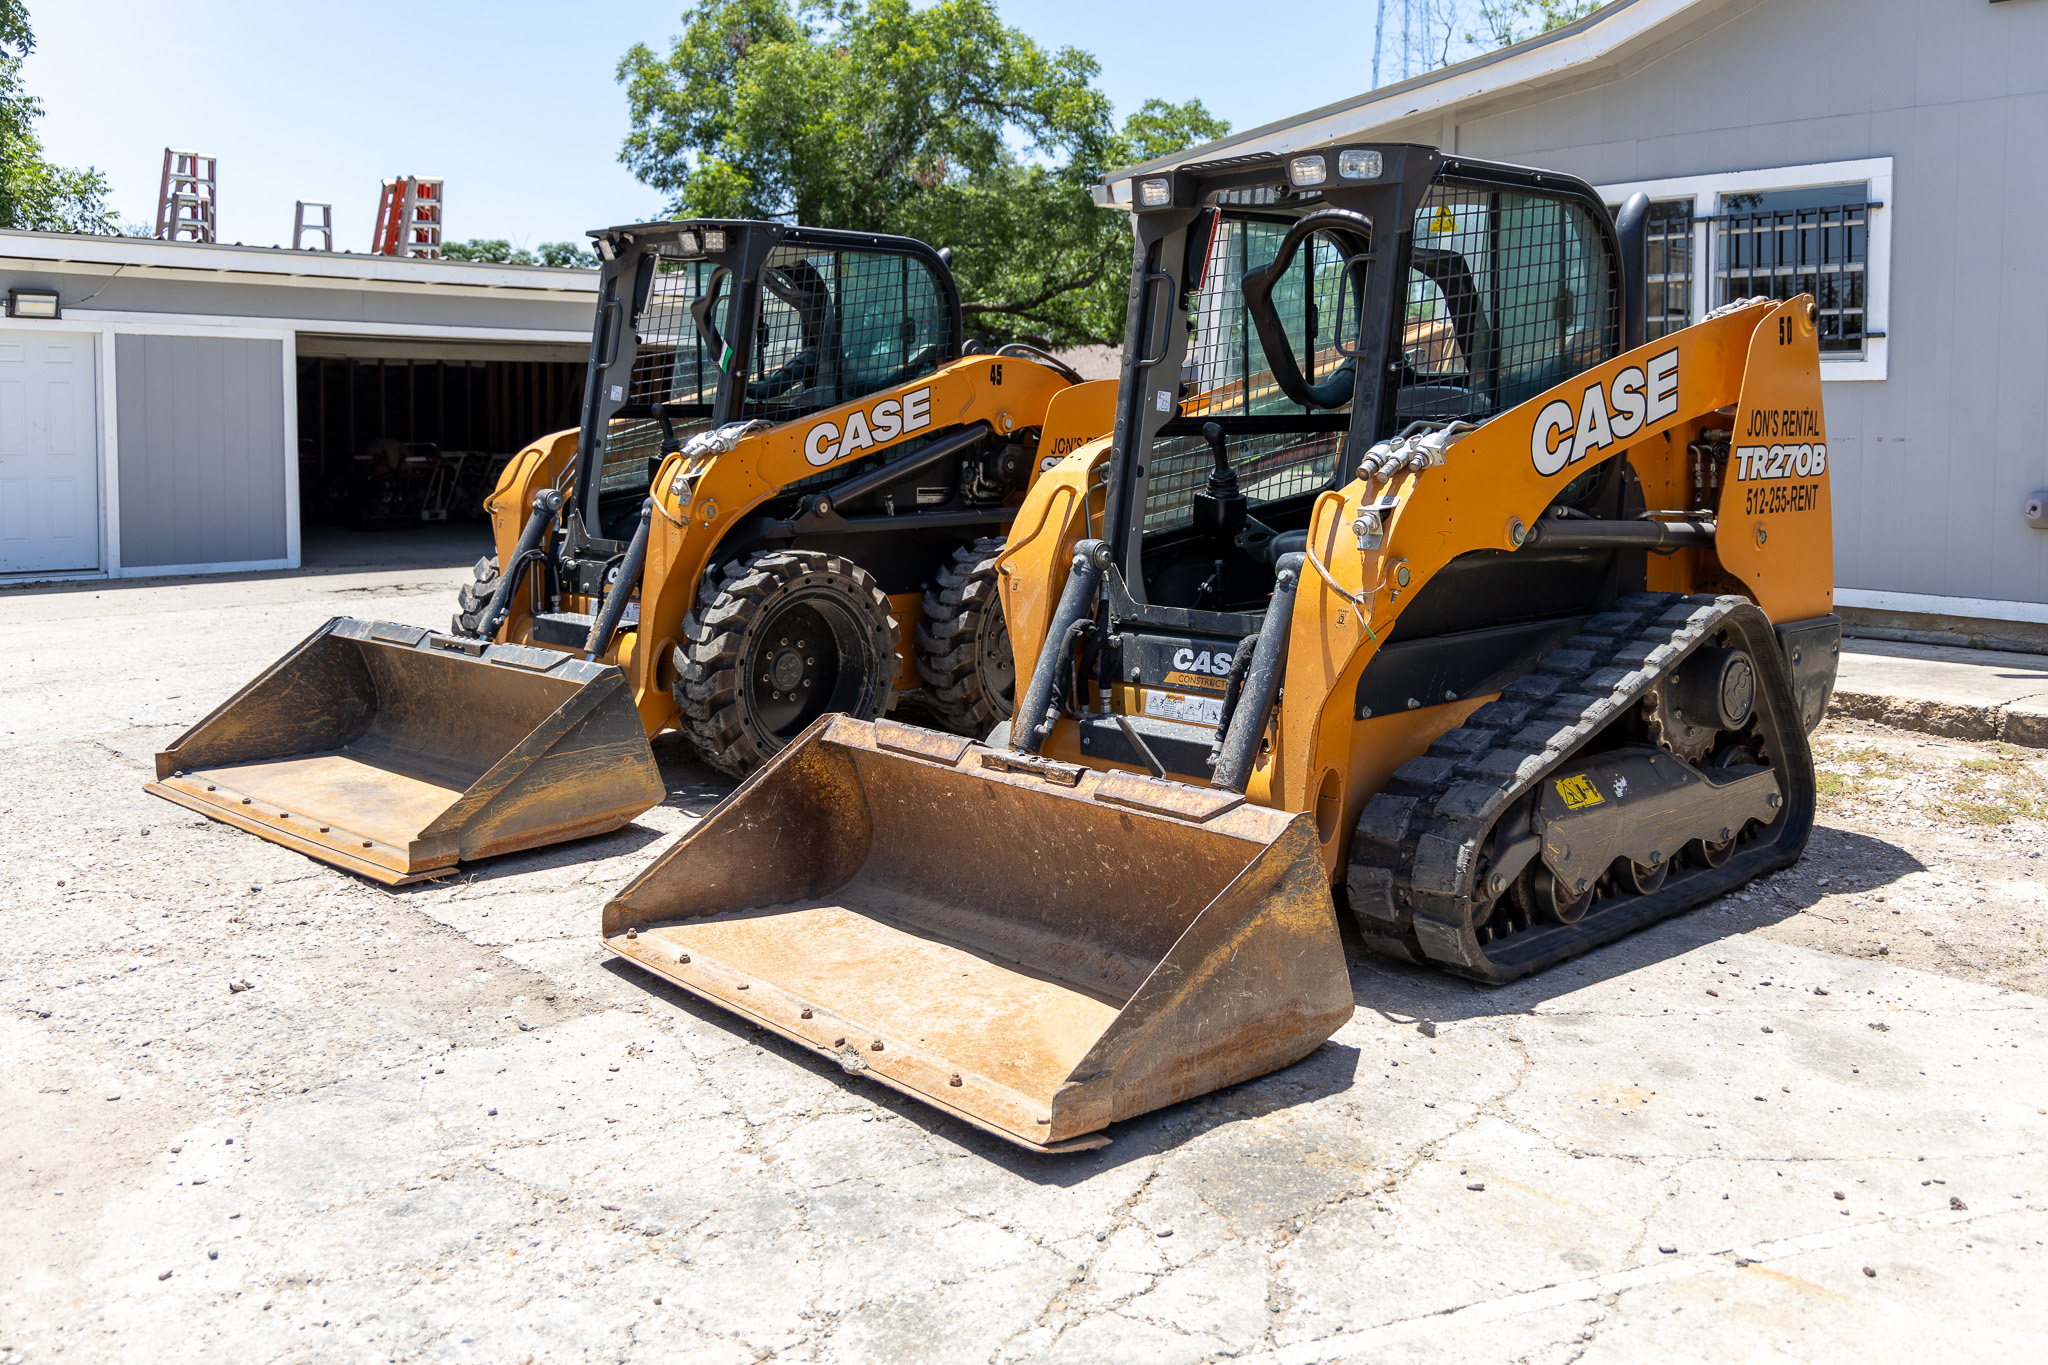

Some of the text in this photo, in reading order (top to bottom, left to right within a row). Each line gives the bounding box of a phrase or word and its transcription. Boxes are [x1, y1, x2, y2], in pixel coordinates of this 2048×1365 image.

[1779, 316, 1793, 346] 50
[990, 364, 1003, 386] 45
[804, 385, 931, 467] CASE
[1530, 346, 1679, 477] CASE
[1747, 409, 1819, 437] JON'S RENTAL
[1735, 442, 1827, 481] TR270B
[1745, 484, 1819, 516] 512-255-RENT
[1173, 647, 1234, 676] CAS
[1178, 674, 1227, 689] CONSTRUCT
